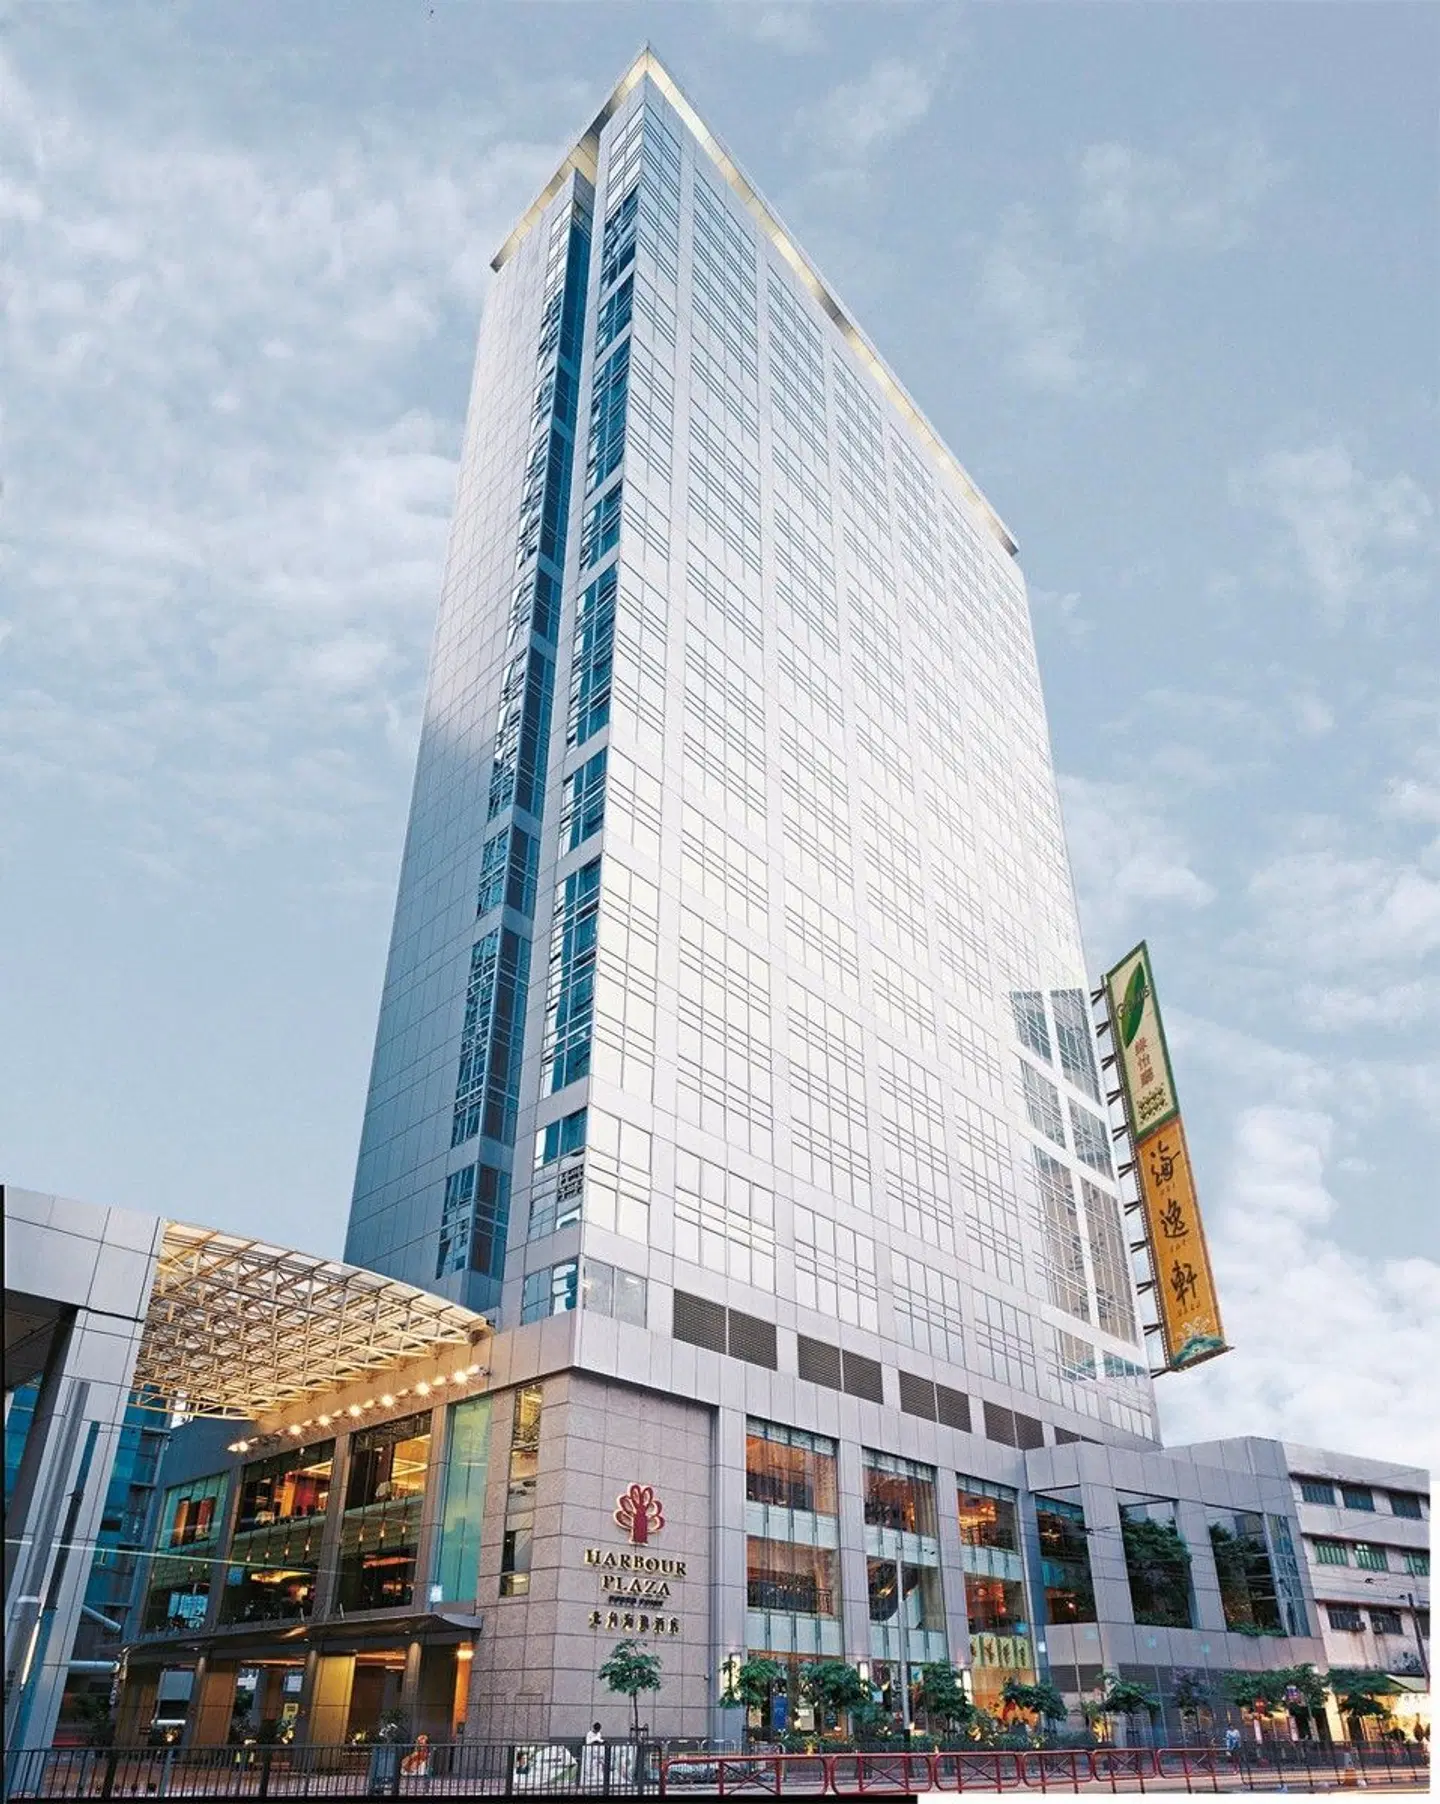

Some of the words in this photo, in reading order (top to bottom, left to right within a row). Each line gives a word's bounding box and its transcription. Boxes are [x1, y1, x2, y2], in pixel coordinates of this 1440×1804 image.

[1150, 1140, 1198, 1307] 海逸軒
[584, 1549, 687, 1578] HARBOUR
[601, 1575, 671, 1597] PLAZA
